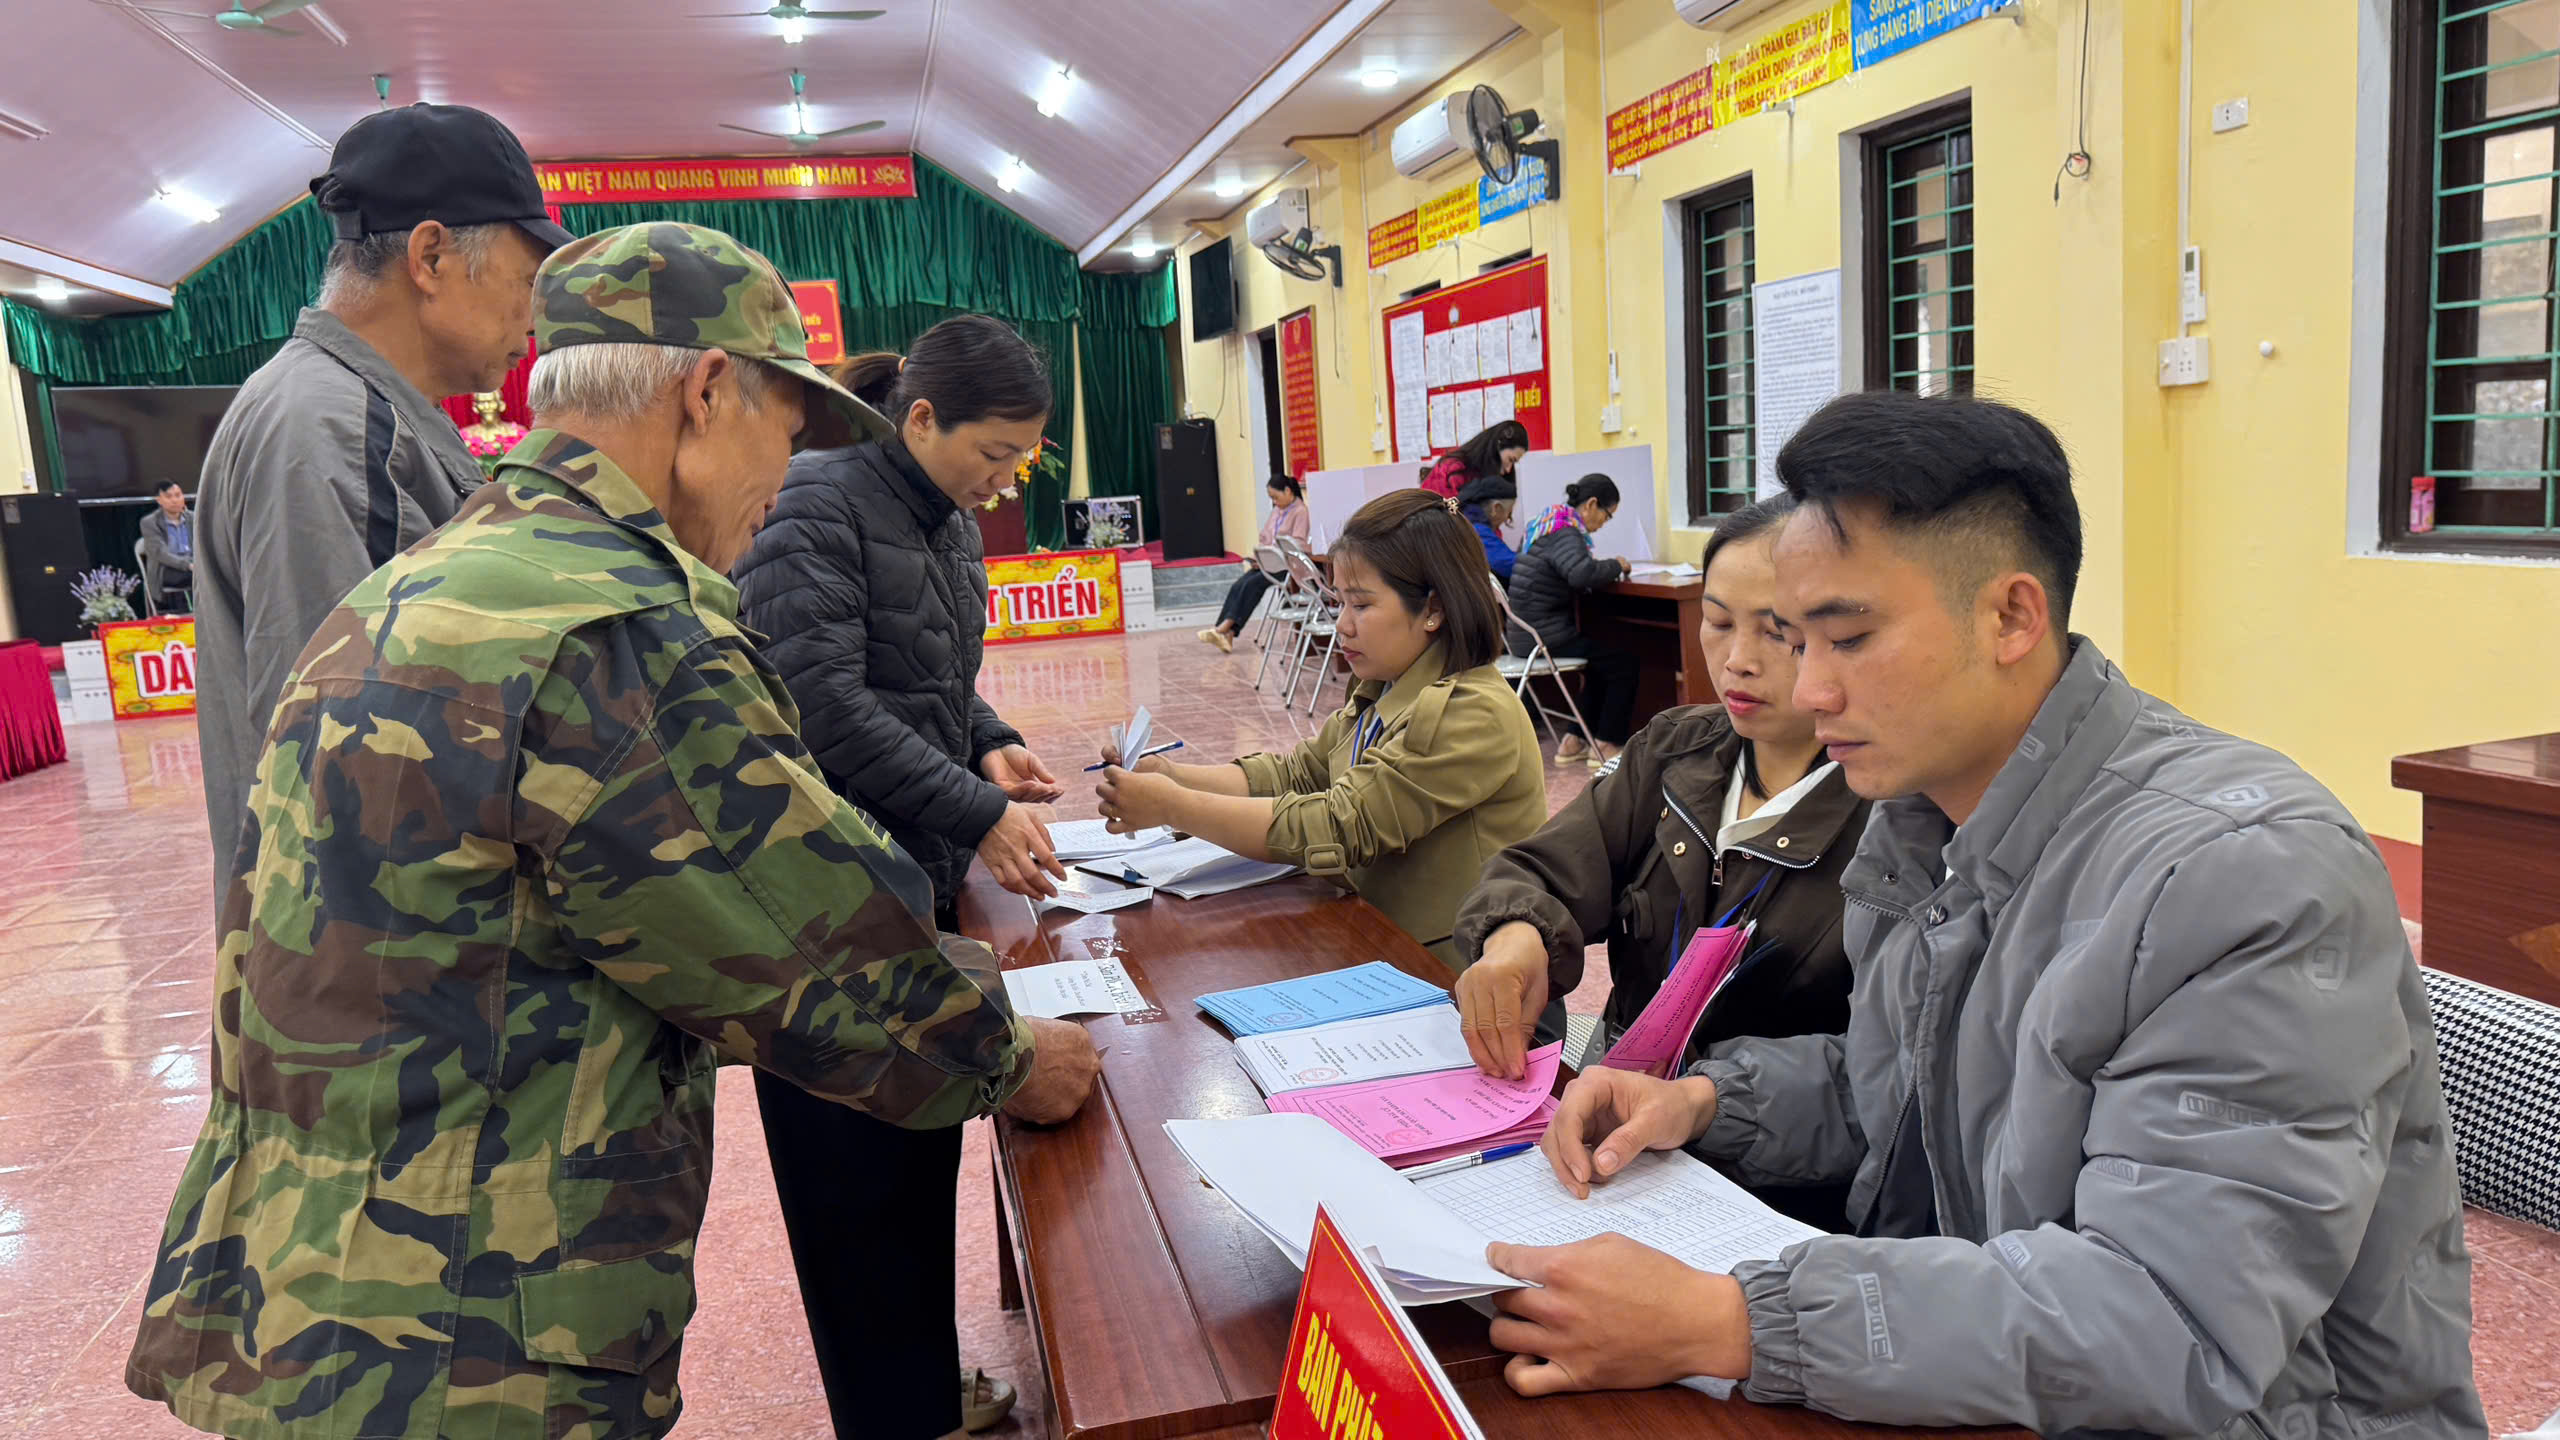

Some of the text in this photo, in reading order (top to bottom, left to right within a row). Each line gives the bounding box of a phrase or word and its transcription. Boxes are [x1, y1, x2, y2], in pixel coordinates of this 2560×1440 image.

[1760, 36, 1784, 58] THAM
[565, 168, 603, 196] VIỆT
[608, 170, 651, 190] NAM
[655, 168, 715, 191] QUANG
[718, 167, 760, 188] VINH
[816, 164, 858, 186] NĂM
[1008, 567, 1098, 622] TRIỂN
[140, 643, 196, 694] DÂ
[1297, 1311, 1384, 1440] BÀN PHÁ
